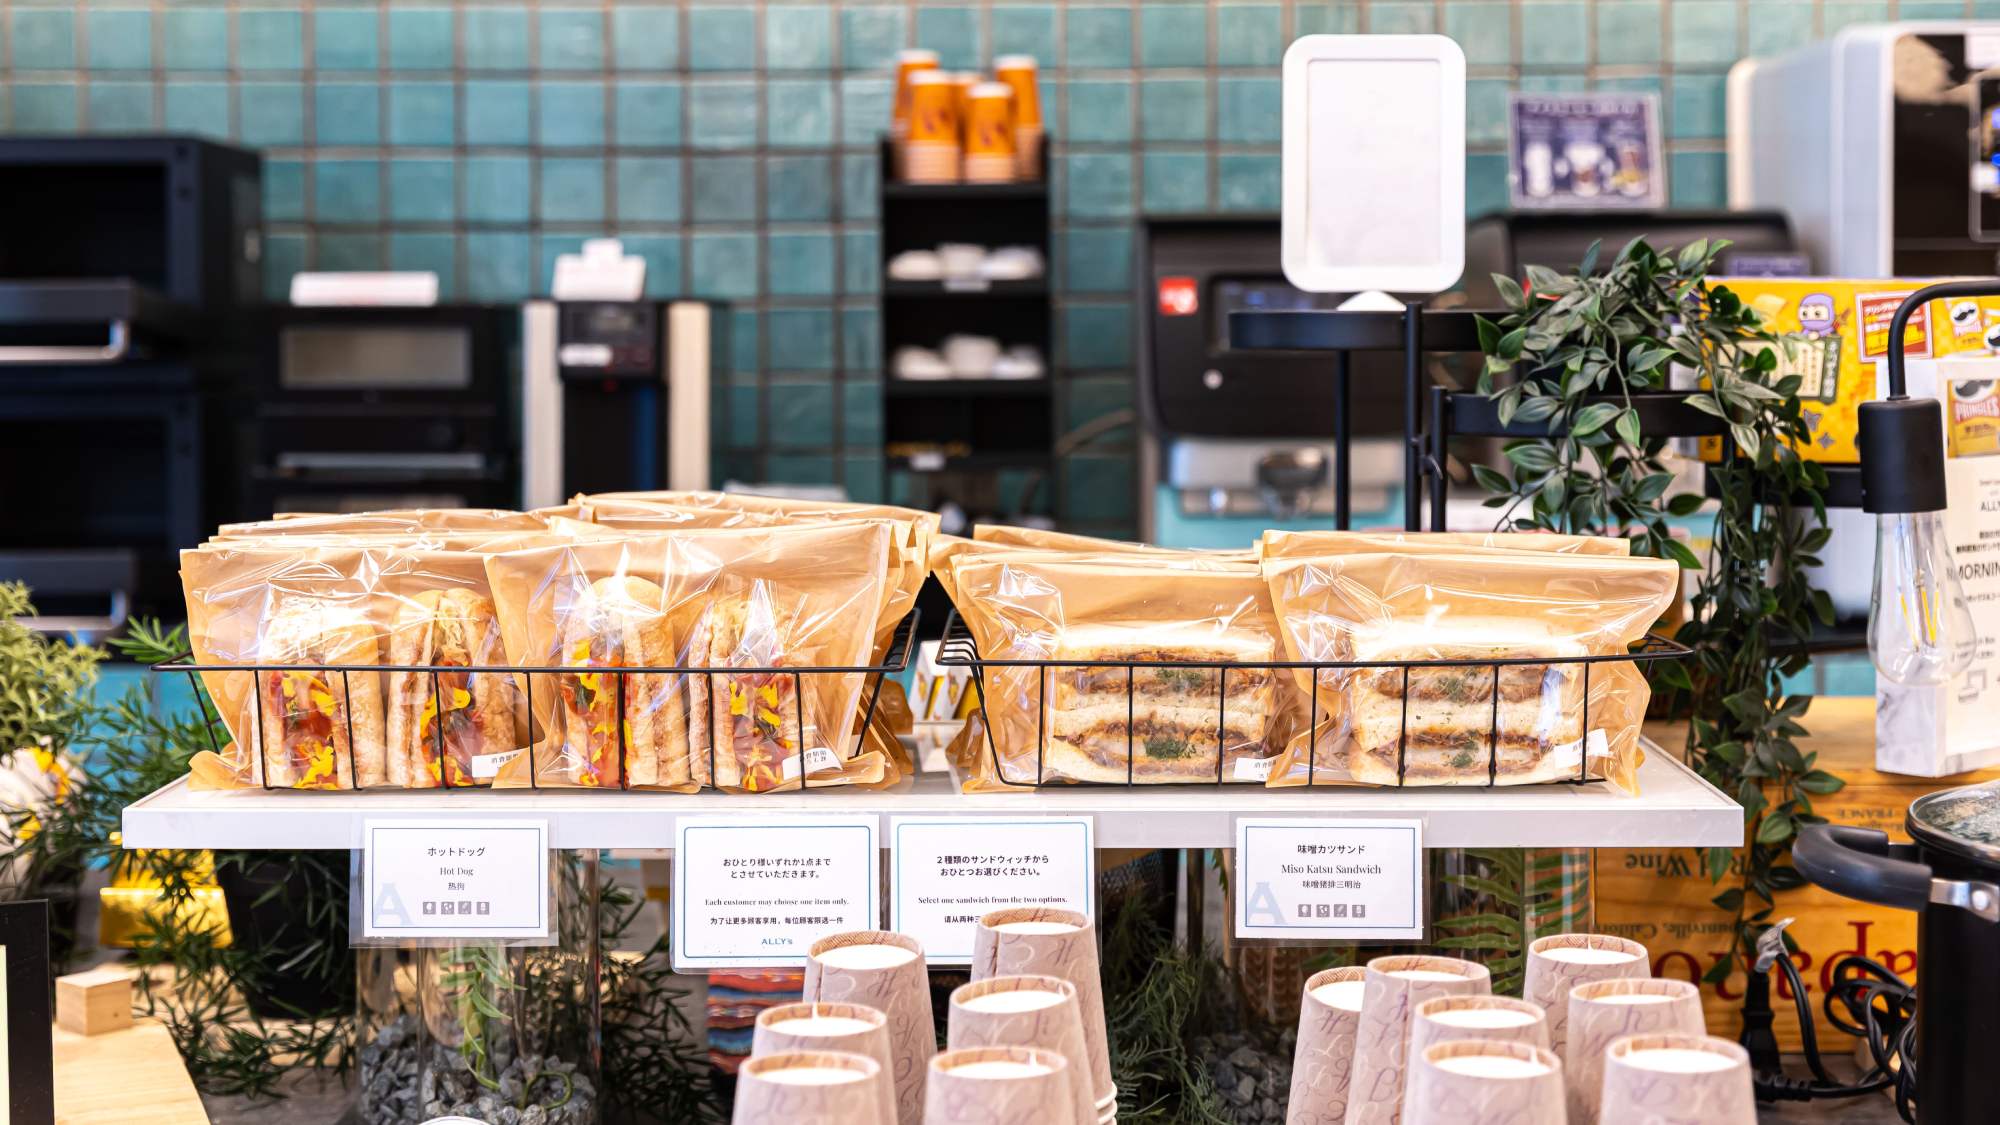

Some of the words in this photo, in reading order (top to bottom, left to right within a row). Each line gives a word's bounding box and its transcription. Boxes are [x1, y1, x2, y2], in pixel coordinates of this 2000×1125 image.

[1981, 502, 2000, 512] ALL
[427, 846, 486, 857] ホットドッグ
[1297, 844, 1366, 856] 味噌カツサンド
[723, 858, 832, 868] おひとり様いずれか1点まで
[936, 855, 1049, 865] 2種類のサンドウィッチから
[439, 866, 455, 876] Hot
[457, 866, 474, 878] Dog
[940, 867, 1041, 877] おひとつお選びください。
[1281, 864, 1305, 874] Miso
[1306, 864, 1334, 874] Katsu
[1335, 864, 1382, 874] Sandwich
[1625, 854, 1691, 880] Wine
[730, 869, 820, 880] とさせていただきます。
[447, 882, 465, 891] 热狗
[1302, 880, 1362, 889] 味噌猪排三明治
[705, 898, 722, 906] Each
[724, 898, 756, 906] customer
[758, 899, 773, 907] may
[774, 897, 798, 905] choose
[814, 897, 831, 905] item
[832, 897, 850, 906] only.
[918, 896, 940, 905] Select
[956, 896, 990, 904] sandwich
[991, 896, 1009, 904] from
[1010, 896, 1023, 904] the
[1038, 896, 1068, 905] options.
